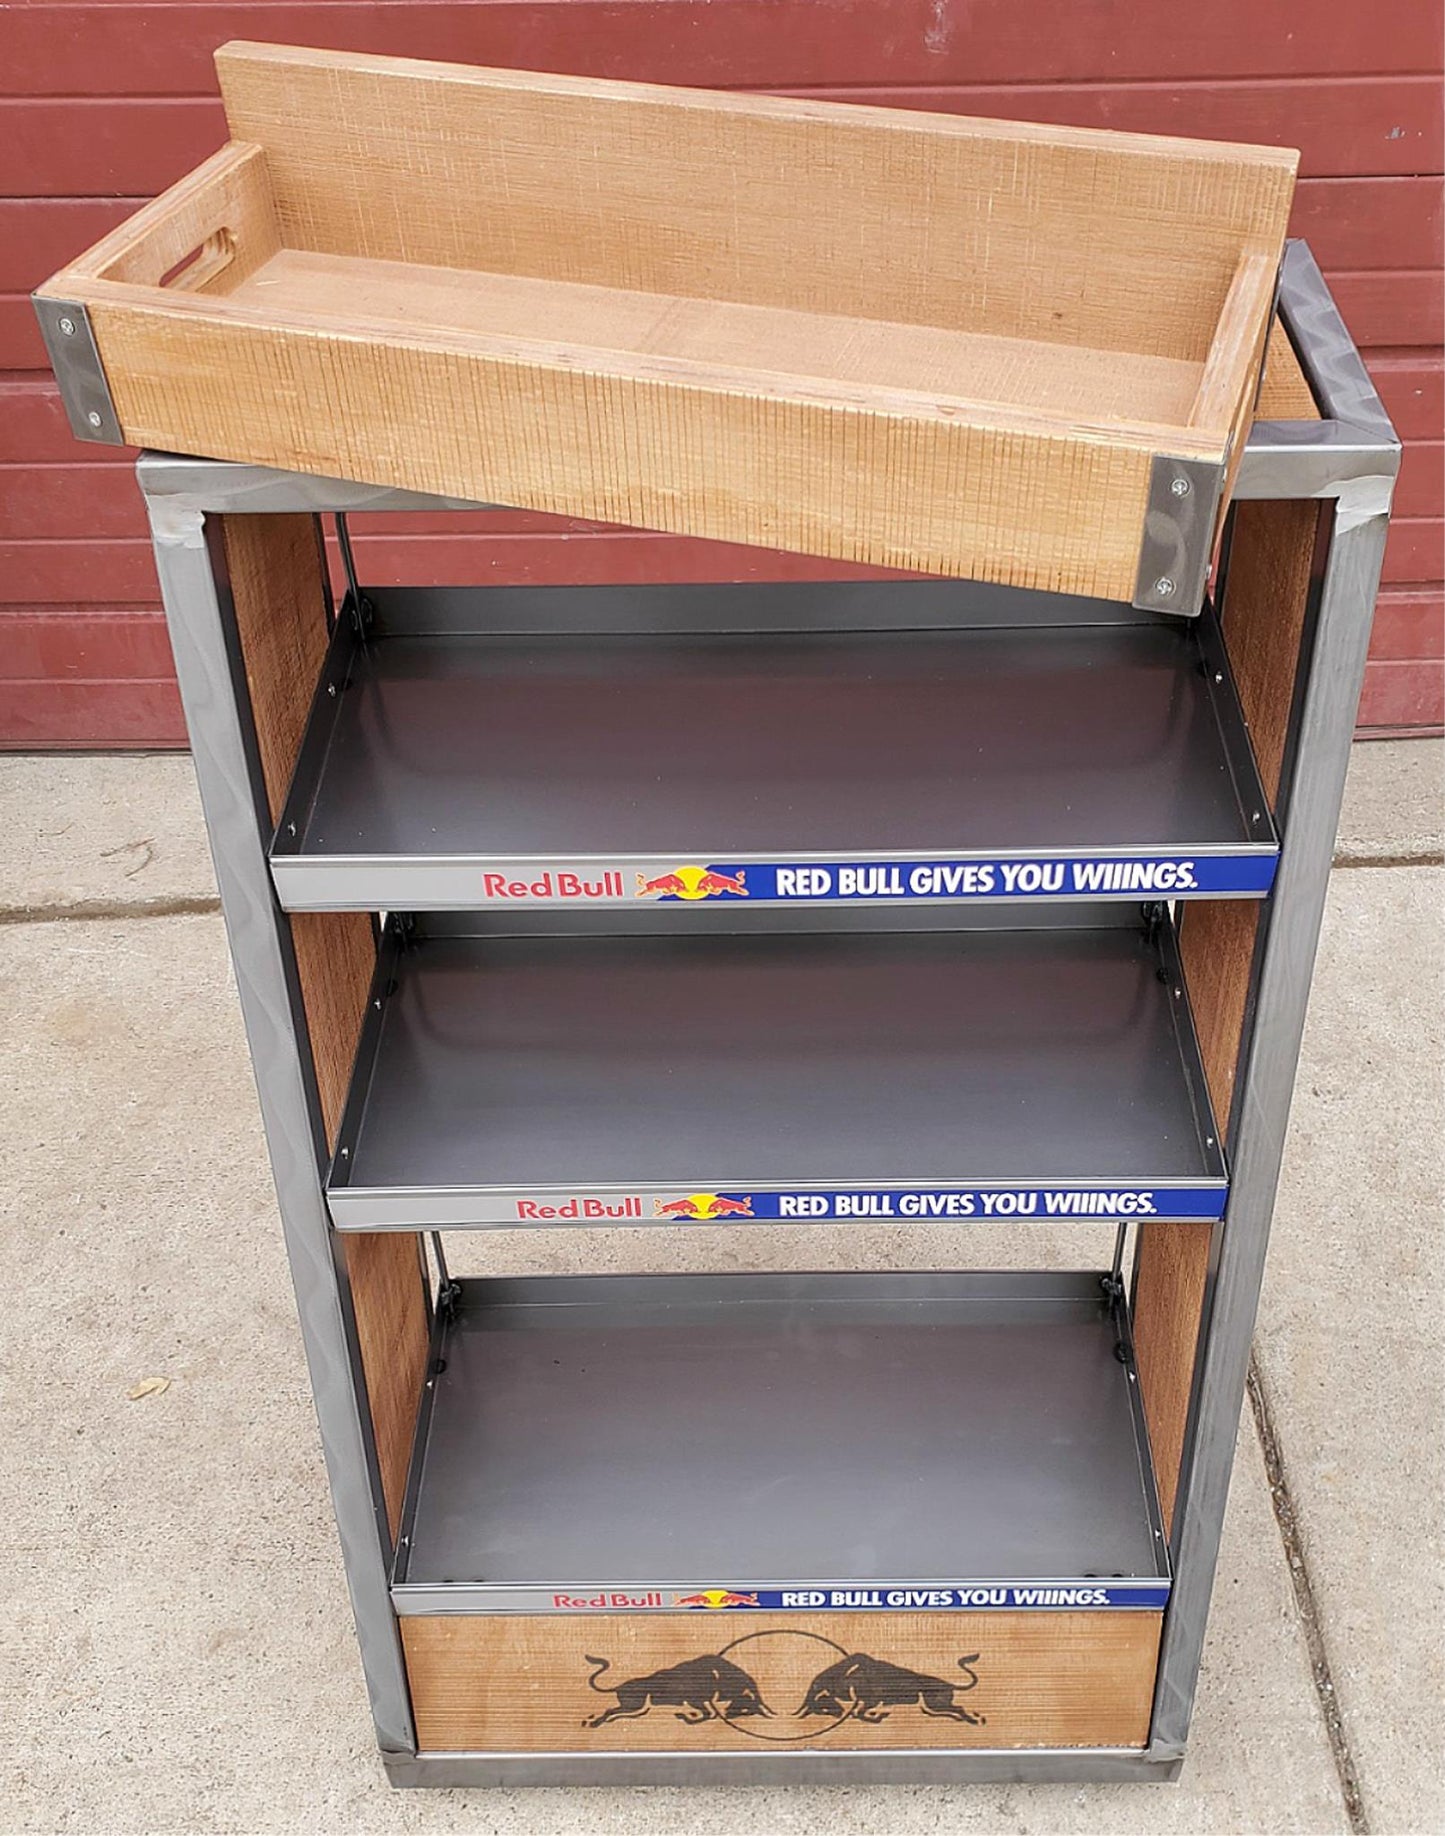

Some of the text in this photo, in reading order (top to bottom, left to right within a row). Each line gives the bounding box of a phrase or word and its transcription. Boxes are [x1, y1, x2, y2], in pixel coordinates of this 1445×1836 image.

[483, 871, 623, 898] Red Bull
[776, 861, 1199, 896] RED BULL GIVES YOU WIIINGS.
[517, 1197, 641, 1219] Red Bull
[779, 1192, 1158, 1216] RED BULL GIVES YOU WIIINGS.
[554, 1592, 661, 1608] Red Bull
[782, 1588, 1111, 1607] RED BULL GIVES YOU WIIINGS.
